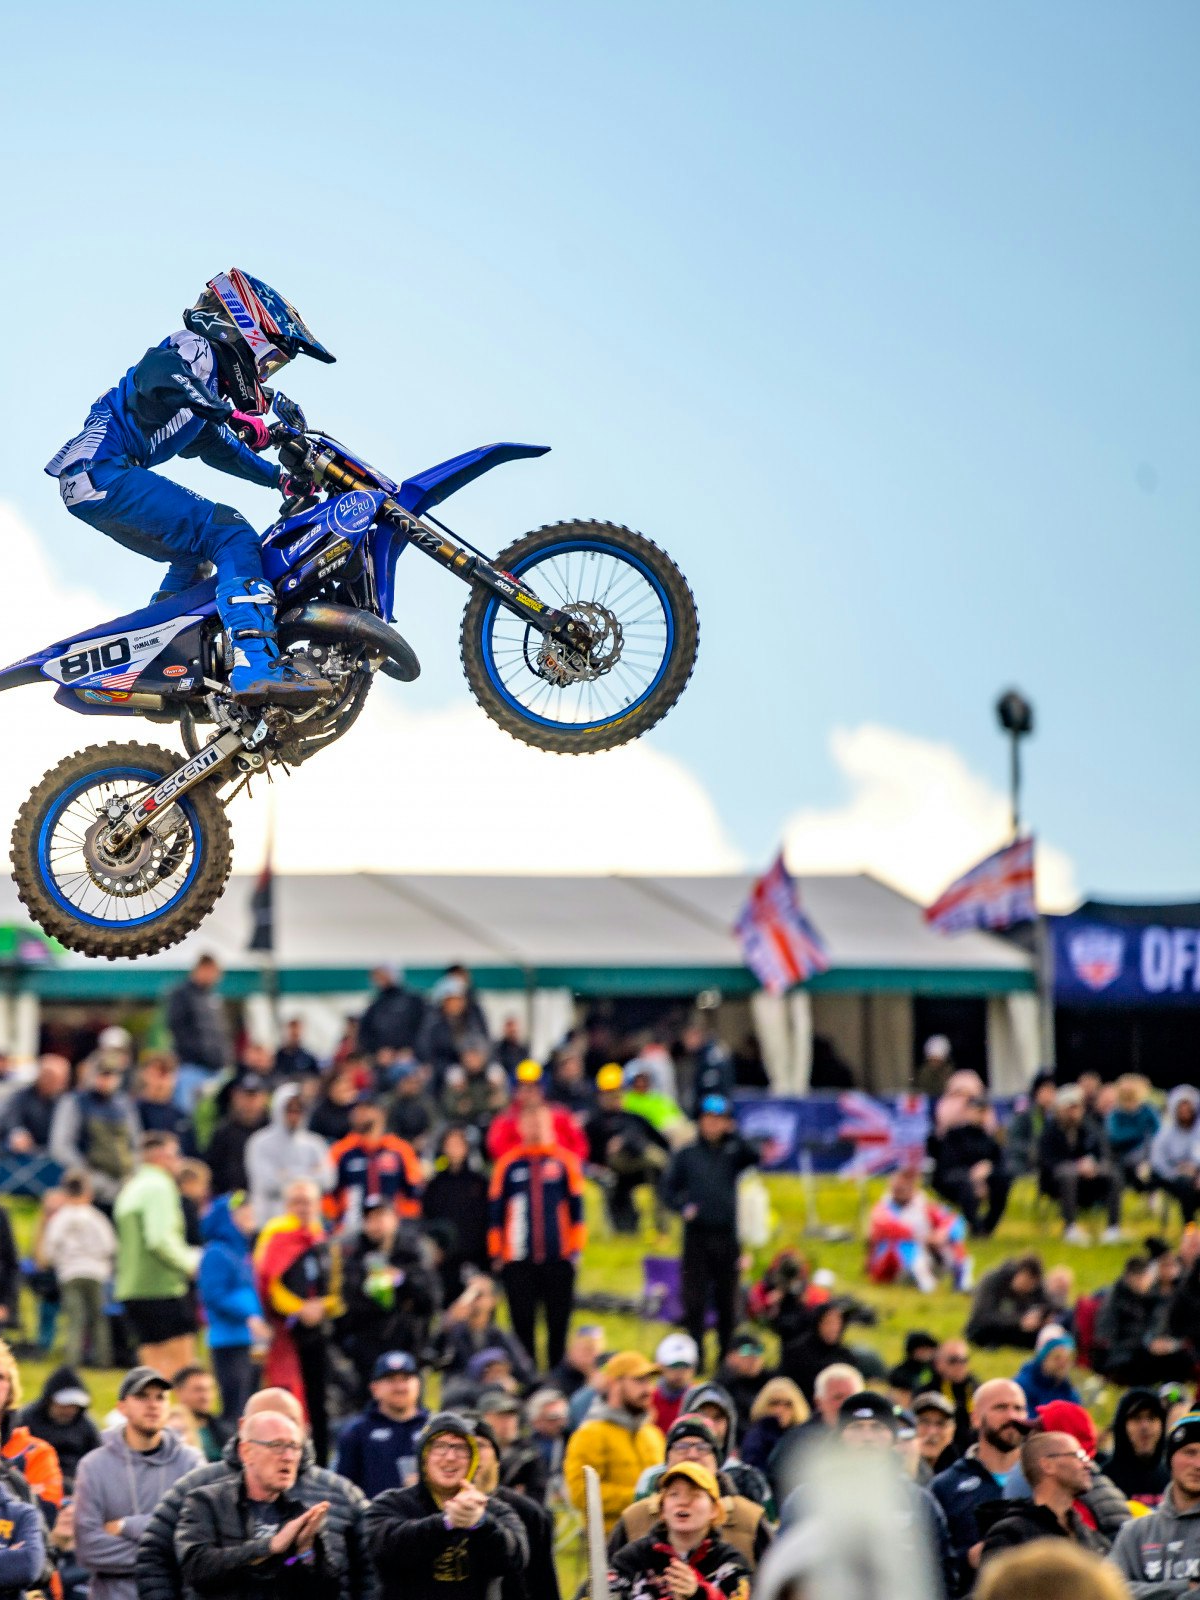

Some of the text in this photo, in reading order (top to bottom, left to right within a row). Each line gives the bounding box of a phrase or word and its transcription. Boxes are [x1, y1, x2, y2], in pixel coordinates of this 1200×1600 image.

[495, 580, 515, 595] SKDA
[133, 637, 160, 650] YAMALUBE
[60, 637, 131, 682] 810
[134, 747, 215, 822] CRESCENT
